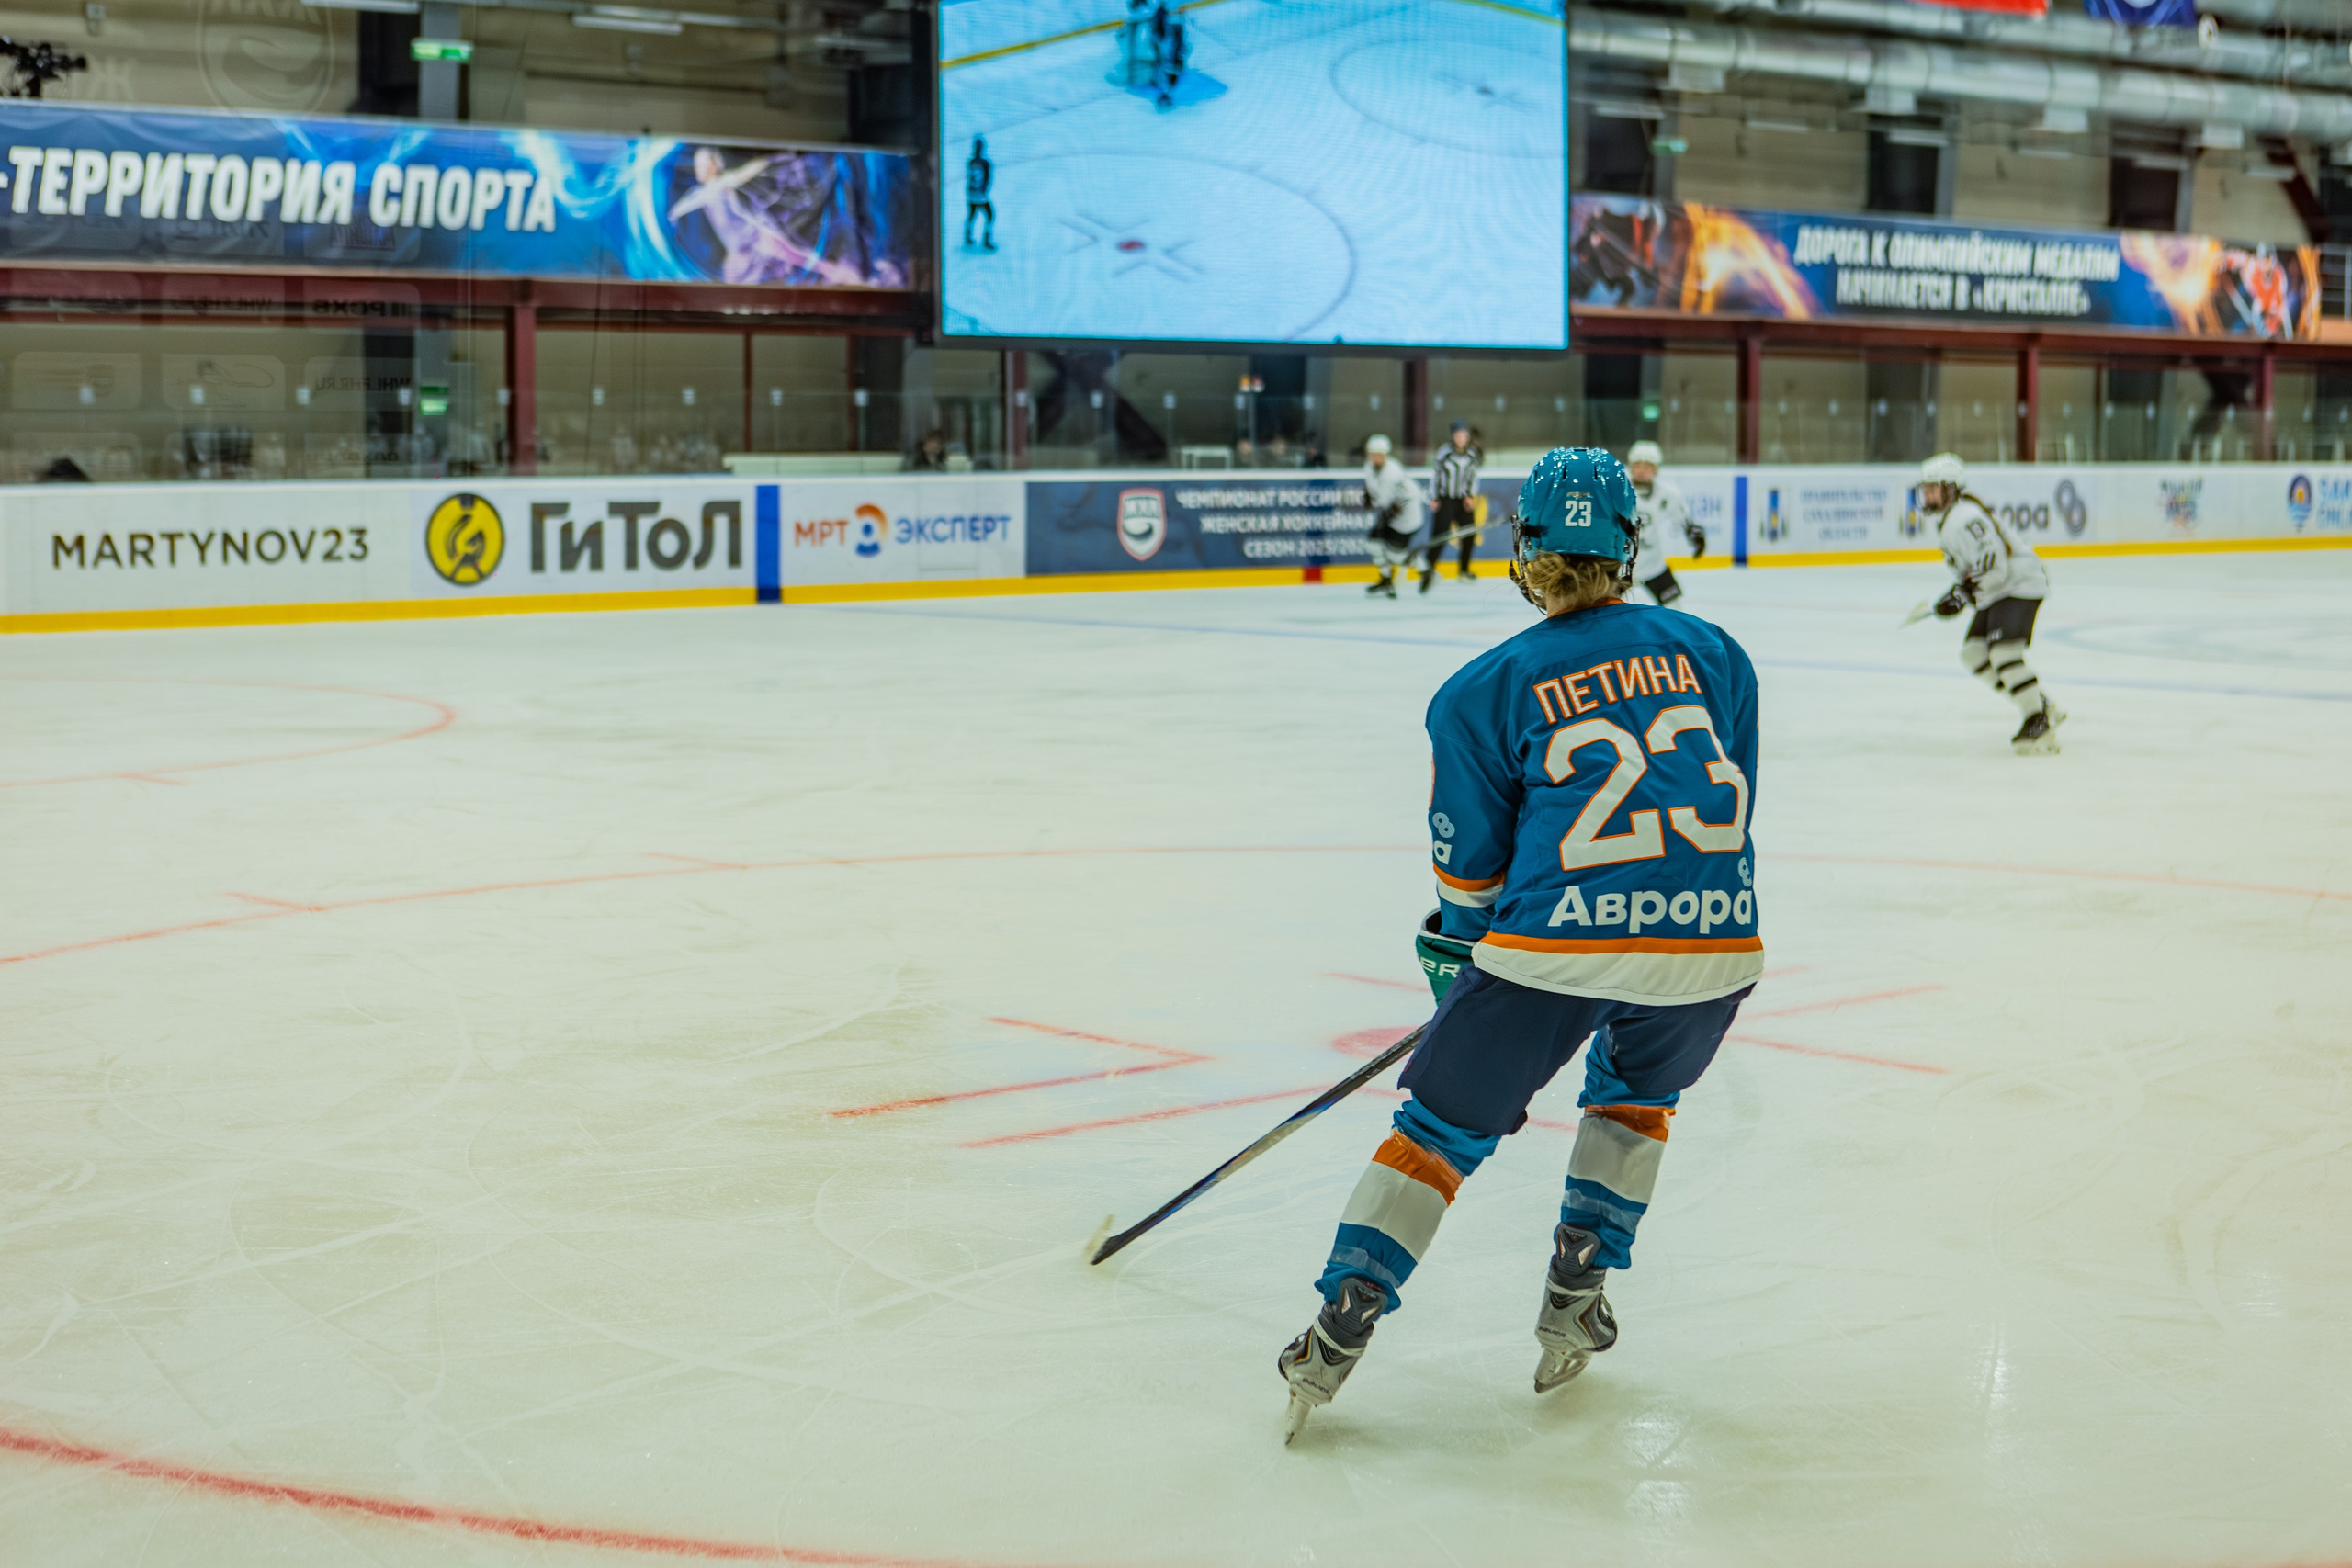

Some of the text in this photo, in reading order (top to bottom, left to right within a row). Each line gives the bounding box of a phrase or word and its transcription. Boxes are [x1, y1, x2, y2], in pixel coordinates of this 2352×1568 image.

[8, 146, 356, 225] ТЕРРИТОРИЯ
[369, 162, 556, 233] СПОРТА
[530, 501, 741, 572] ГиТоЛ
[794, 514, 1012, 548] МРТ ЭКСПЕРТ
[1200, 513, 1279, 534] ЖЕНСКАЯ
[1565, 500, 1592, 527] 23
[51, 527, 369, 570] MARTYNOV23
[1532, 654, 1703, 725] ПЕТИНА
[1544, 705, 1749, 872] 23
[1547, 886, 1753, 935] Аврора
